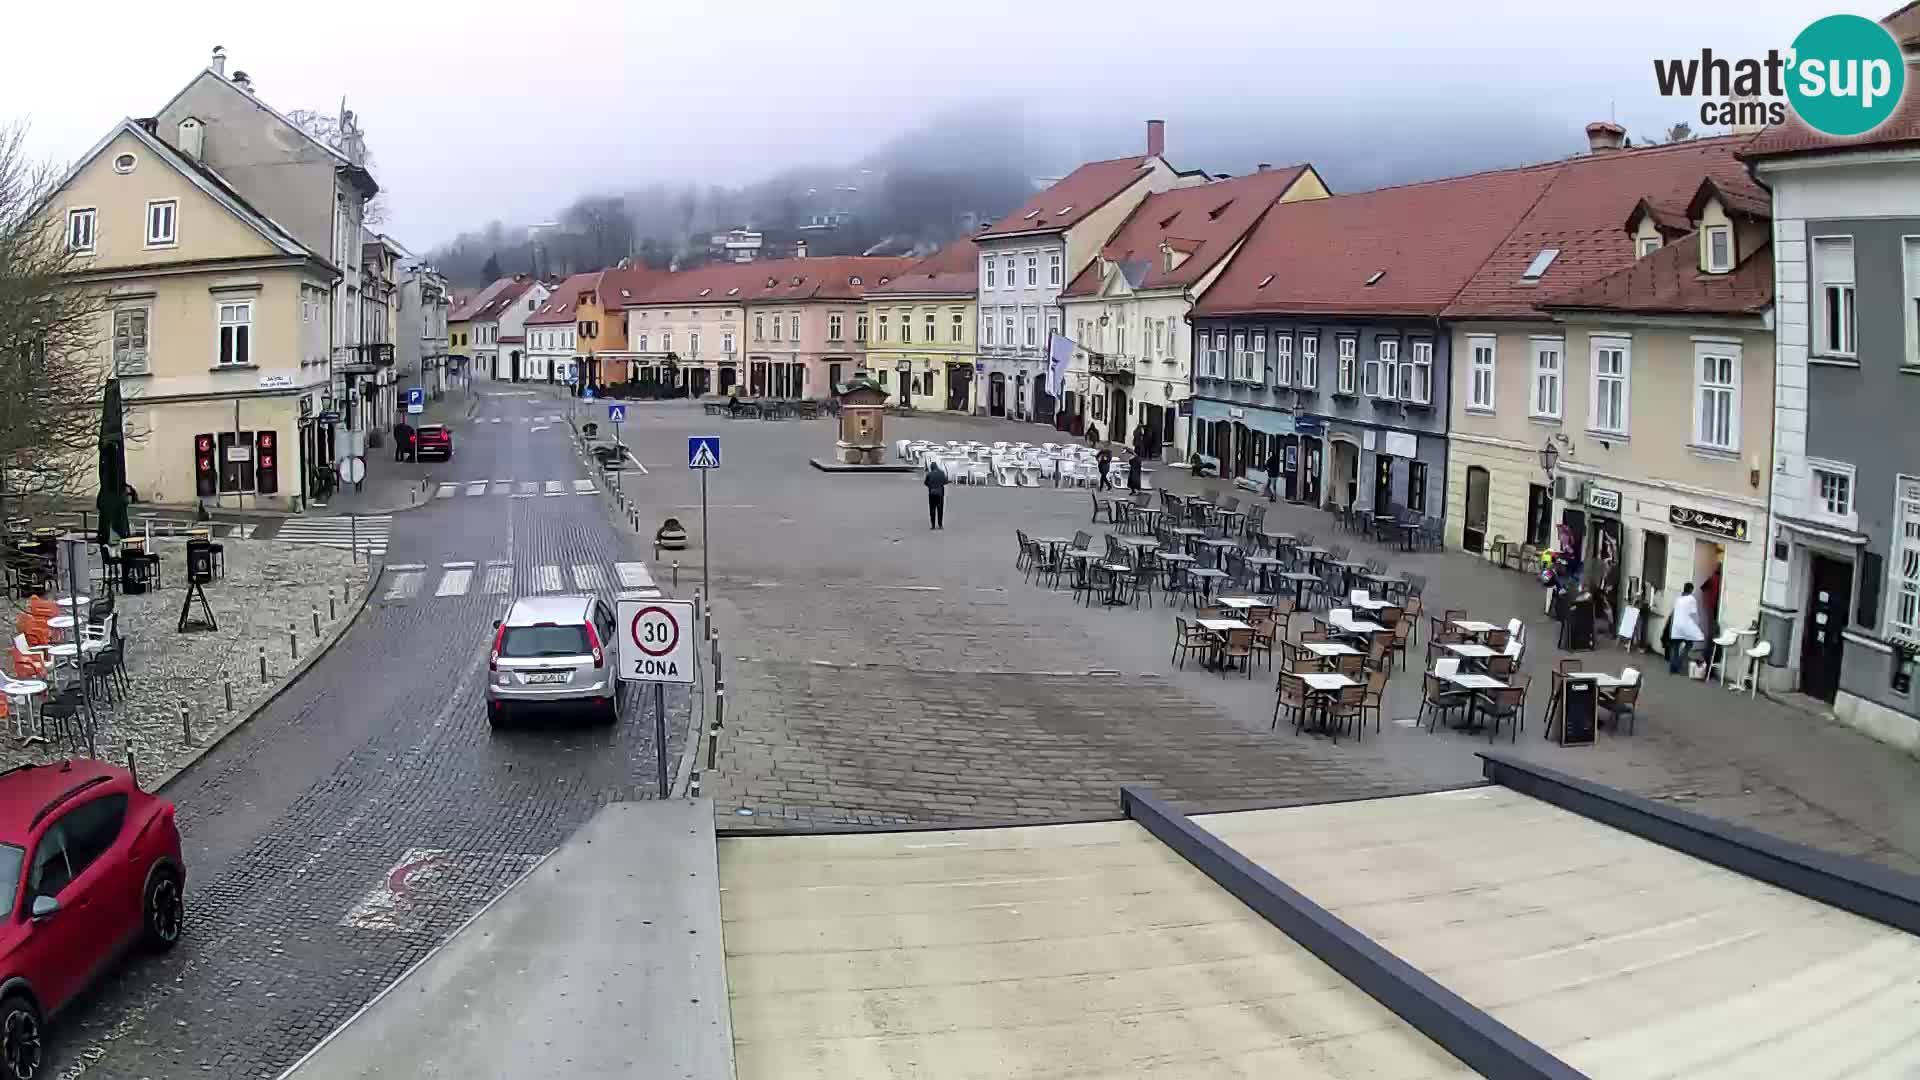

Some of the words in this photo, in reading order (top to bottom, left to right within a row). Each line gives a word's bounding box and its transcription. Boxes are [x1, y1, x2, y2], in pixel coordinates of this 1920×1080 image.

[411, 391, 419, 402] P
[644, 622, 668, 643] 30
[635, 659, 678, 676] ZONA
